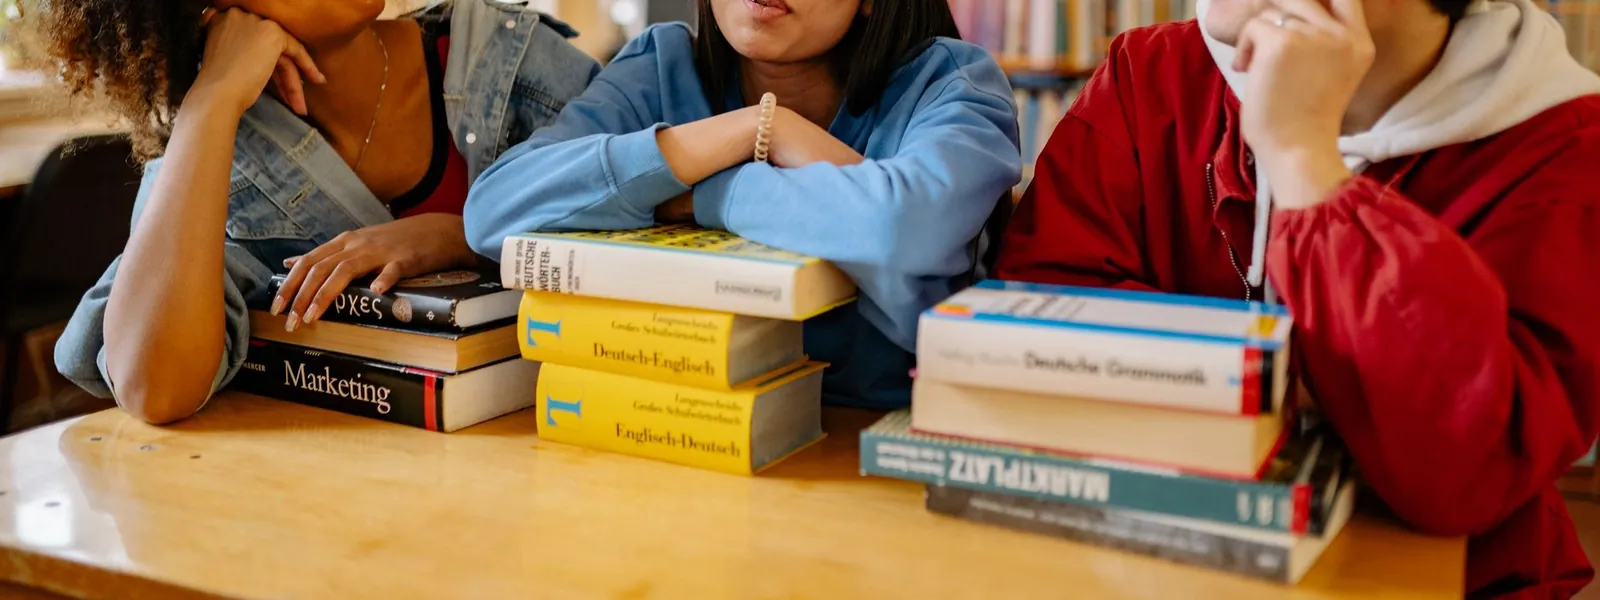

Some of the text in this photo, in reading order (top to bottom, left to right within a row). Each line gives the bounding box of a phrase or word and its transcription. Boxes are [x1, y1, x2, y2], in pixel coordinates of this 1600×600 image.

[524, 240, 537, 289] DEUTSCHE
[551, 266, 561, 292] BUCH
[593, 342, 716, 376] Deutsch-Englisch
[1024, 350, 1100, 375] Deutsche
[1106, 360, 1208, 387] Grammatik
[284, 360, 391, 414] Marketing
[615, 422, 741, 458] Englisch-Deutsch
[949, 451, 1110, 502] MARKTPLATZ
